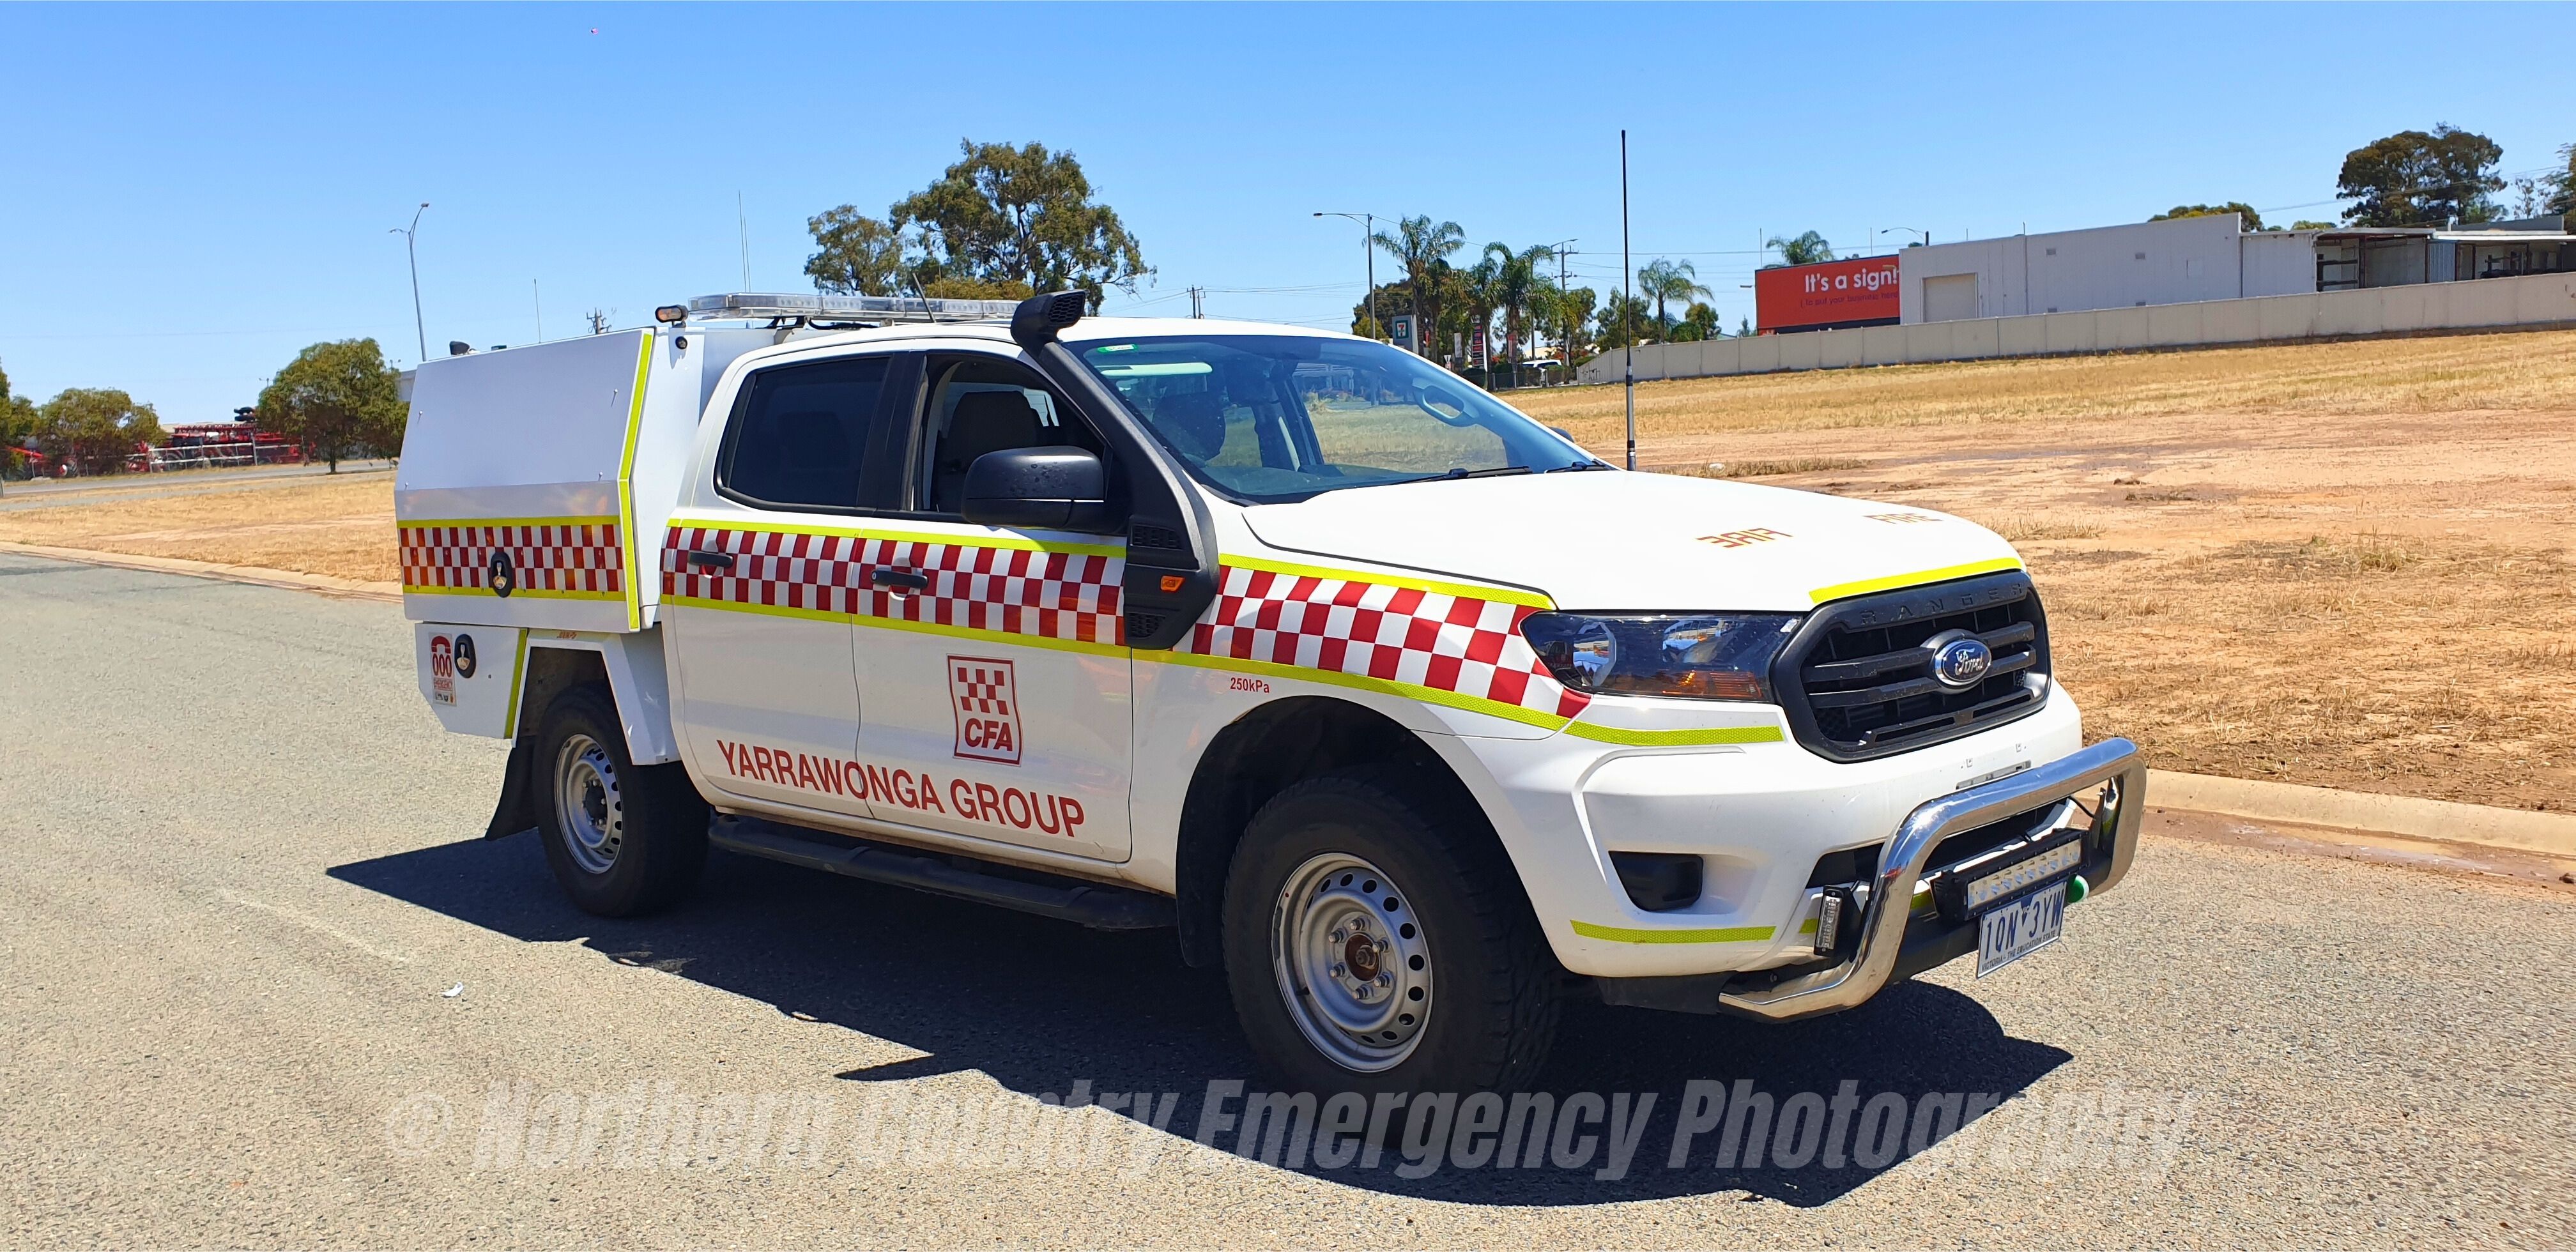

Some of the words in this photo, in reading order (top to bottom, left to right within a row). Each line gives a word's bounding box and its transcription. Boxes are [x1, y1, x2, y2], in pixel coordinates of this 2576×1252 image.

[1805, 273, 1829, 293] It's
[1835, 275, 1847, 289] a
[1853, 268, 1897, 291] sign!
[1859, 583, 2023, 625] RANGER
[433, 653, 452, 677] 000
[1955, 647, 1984, 676] Ford
[1230, 677, 1270, 693] 250kPa
[965, 717, 1013, 752] CFA
[716, 739, 946, 814] YARRAWONGA
[949, 778, 1085, 837] GROUP
